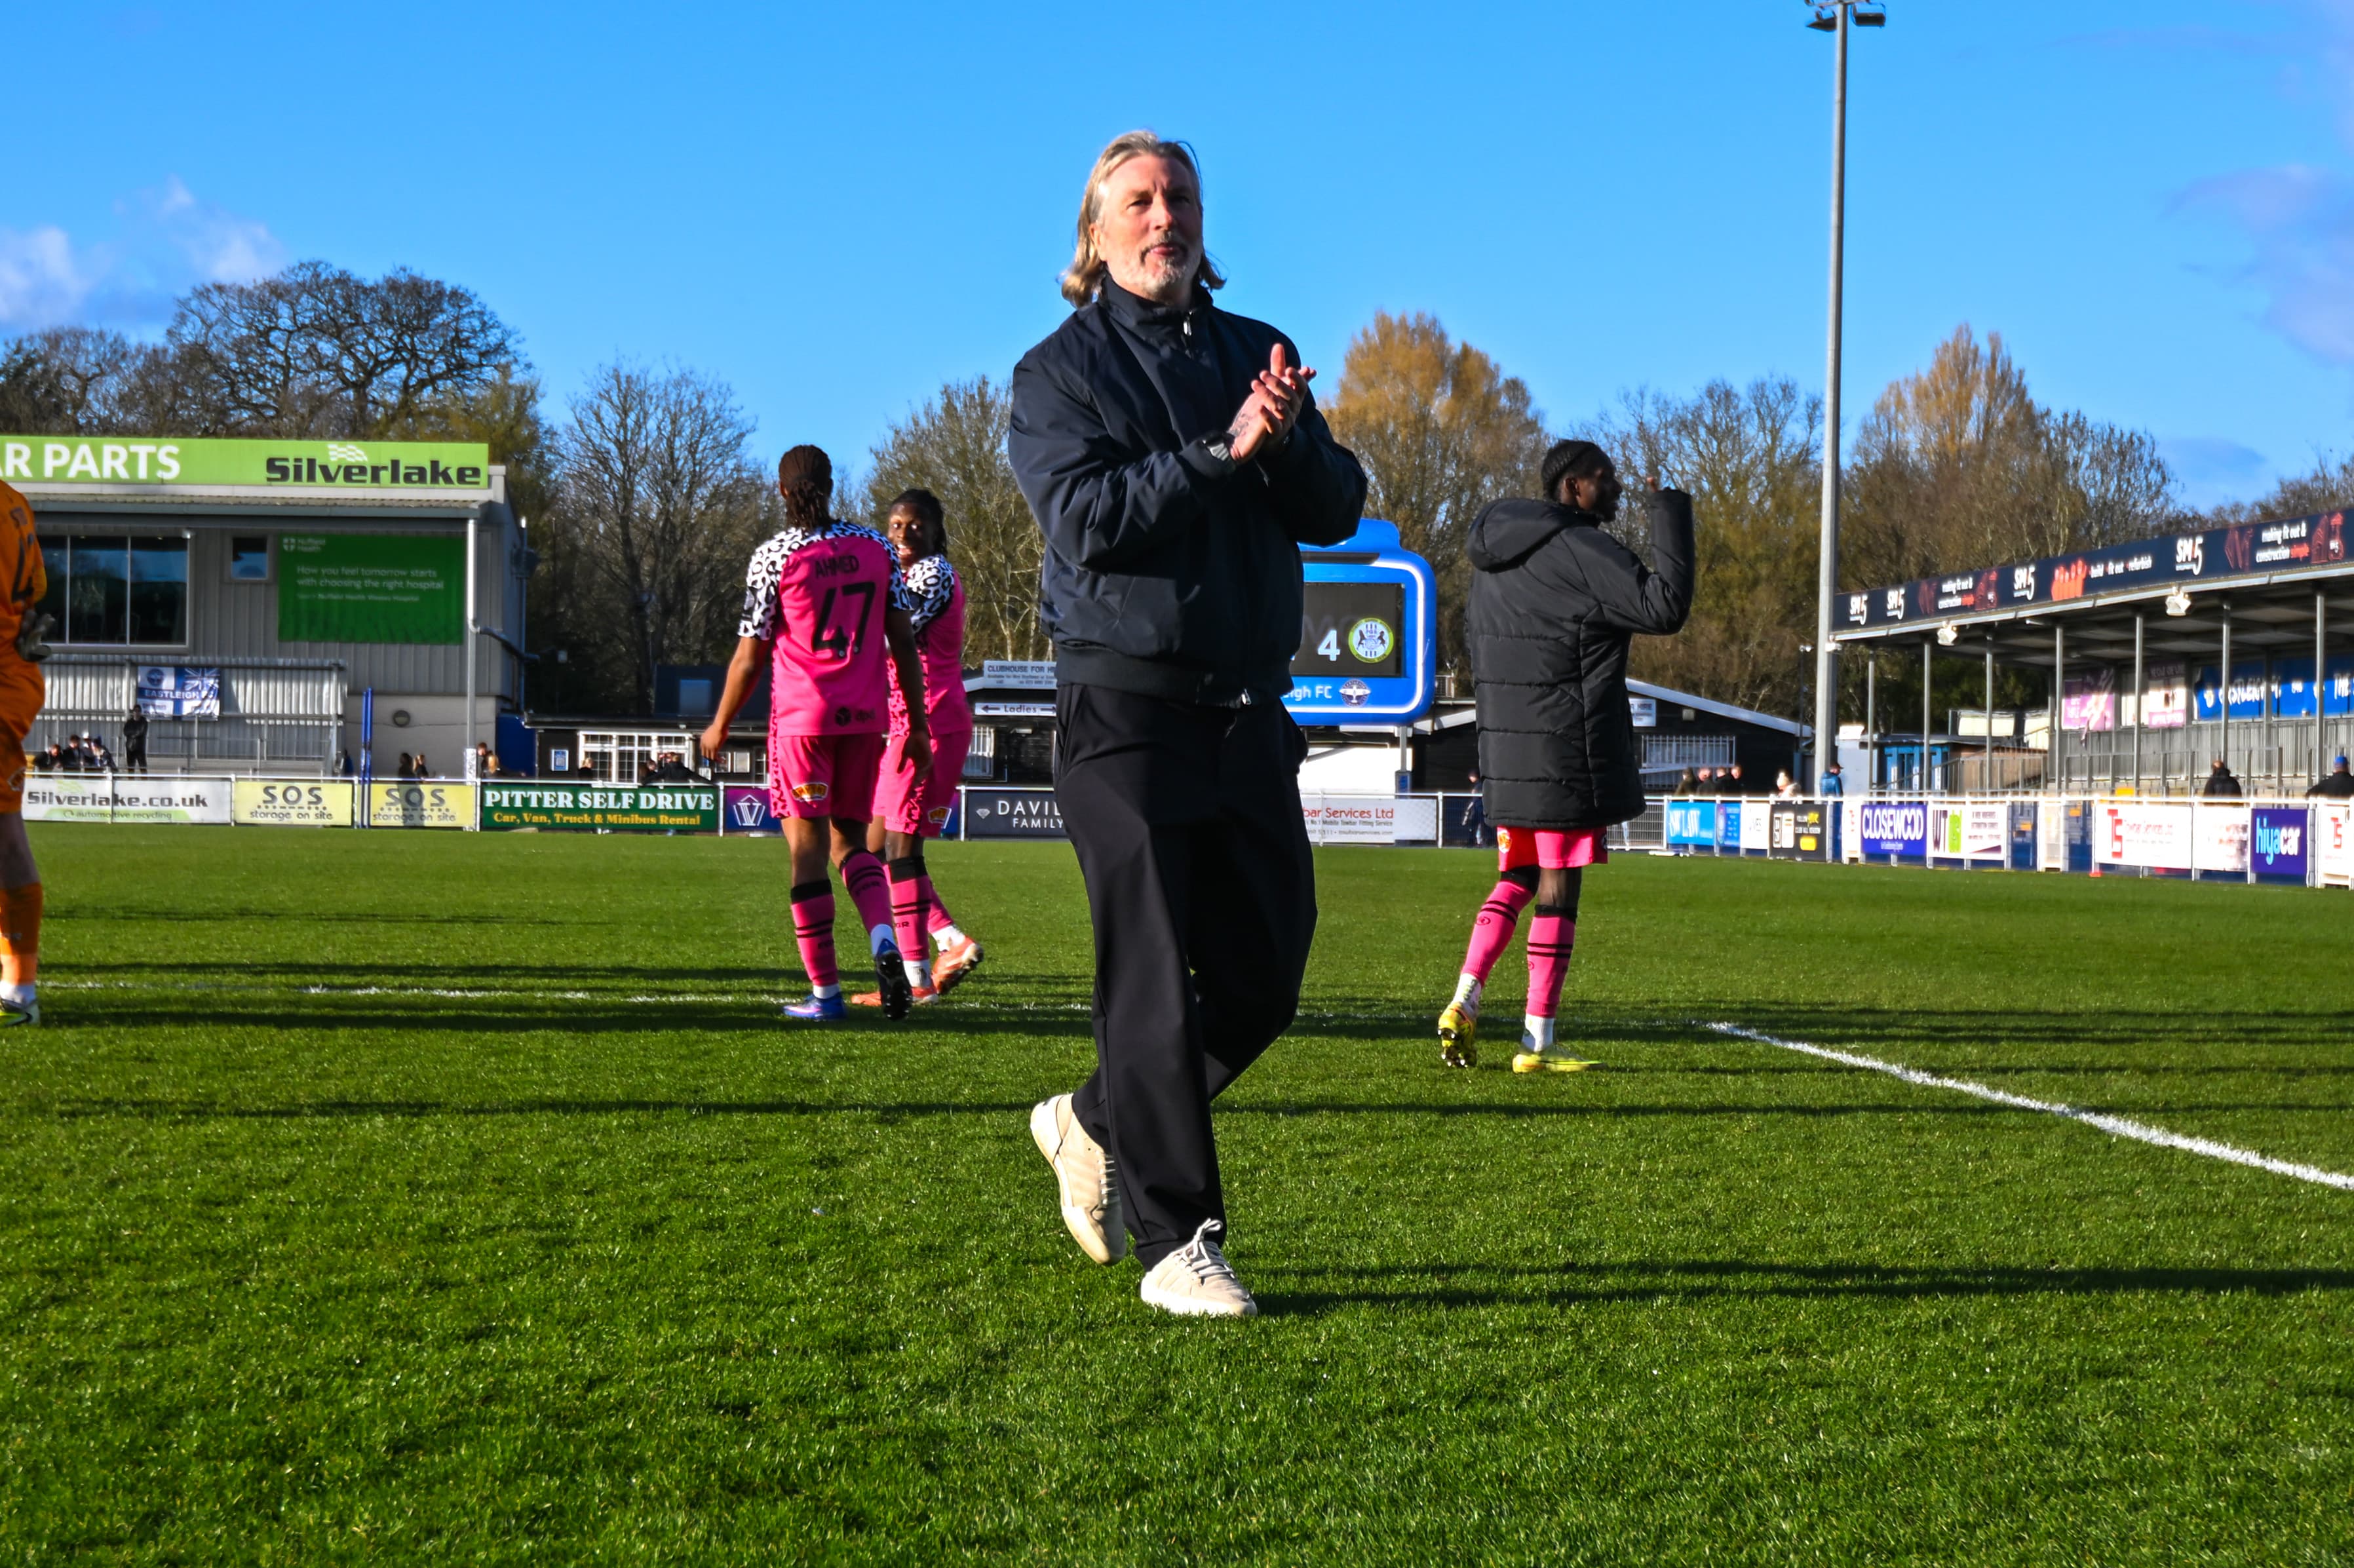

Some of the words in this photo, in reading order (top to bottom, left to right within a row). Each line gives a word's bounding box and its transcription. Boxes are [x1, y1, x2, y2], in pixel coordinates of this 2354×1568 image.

[0, 443, 33, 478] R
[44, 443, 180, 480] PARTS
[266, 457, 481, 485] Silverlake
[297, 565, 318, 575] How
[321, 567, 339, 577] you
[341, 567, 358, 575] feel
[361, 567, 407, 577] tomorrow
[410, 568, 437, 577] starts
[815, 555, 859, 578] AHMED
[298, 577, 317, 586] with
[320, 577, 362, 589] choosing
[364, 579, 380, 588] the
[383, 579, 404, 590] right
[406, 581, 444, 591] hospital
[813, 581, 876, 656] 47
[1317, 630, 1341, 661] 4
[1315, 685, 1333, 699] FC
[1004, 704, 1037, 714] Ladies
[28, 791, 208, 807] Silverlake.co.uk
[263, 785, 323, 805] SOS
[385, 788, 446, 808] SOS
[484, 790, 574, 809] PITTER
[578, 791, 636, 810] SELF
[639, 793, 715, 811] DRIVE
[133, 811, 172, 820] recycling
[250, 810, 291, 822] storage
[297, 812, 310, 820] on
[315, 810, 333, 820] site
[373, 813, 415, 822] storage
[437, 812, 456, 822] site
[493, 813, 520, 824] Car,
[522, 813, 551, 825] Van,
[554, 813, 590, 824] Truck
[594, 814, 604, 824] &
[606, 813, 657, 825] Minibus
[659, 814, 701, 826] Rental
[1325, 807, 1372, 819] Services
[1376, 808, 1394, 819] Ltd
[1013, 818, 1064, 829] FAMILY
[1862, 808, 1924, 841] CLOSEWOOD
[2256, 816, 2300, 866] hiyacar
